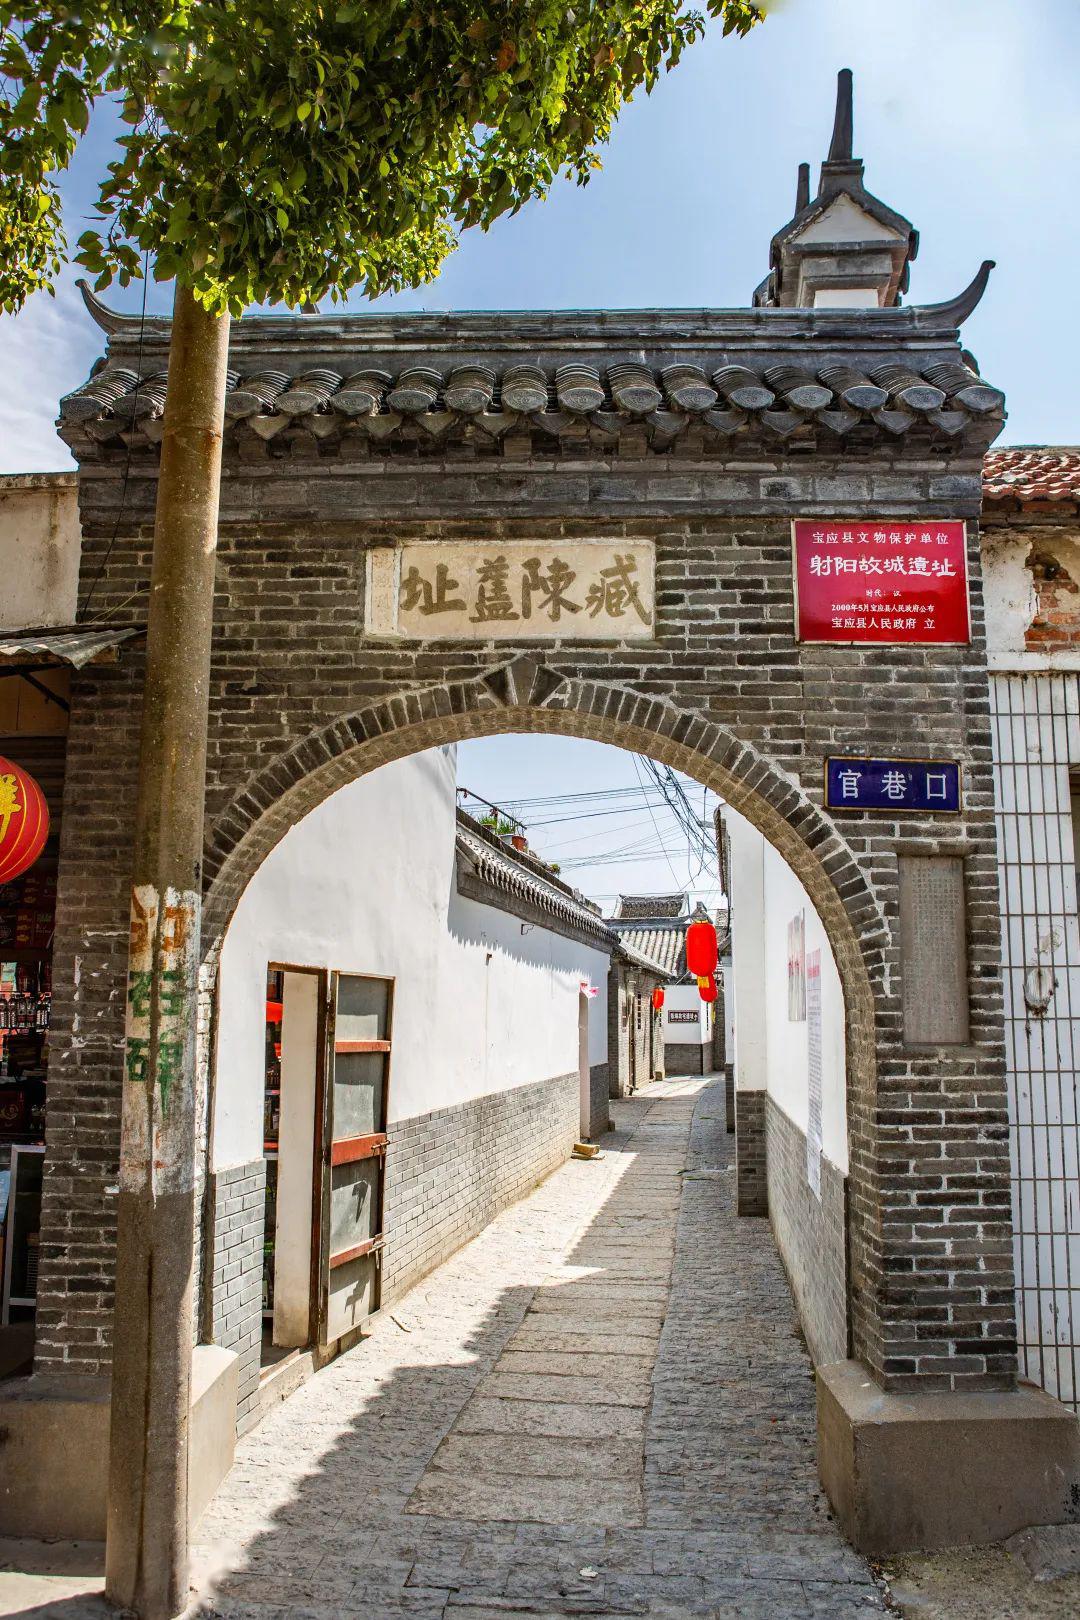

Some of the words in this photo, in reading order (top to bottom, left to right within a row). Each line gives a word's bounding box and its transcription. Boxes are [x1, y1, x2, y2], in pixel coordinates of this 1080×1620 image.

[812, 532, 949, 545] 宝应县文物保护单位
[831, 616, 917, 629] 宝应县人民政府
[924, 618, 936, 629] 立
[838, 769, 947, 800] 官巷口
